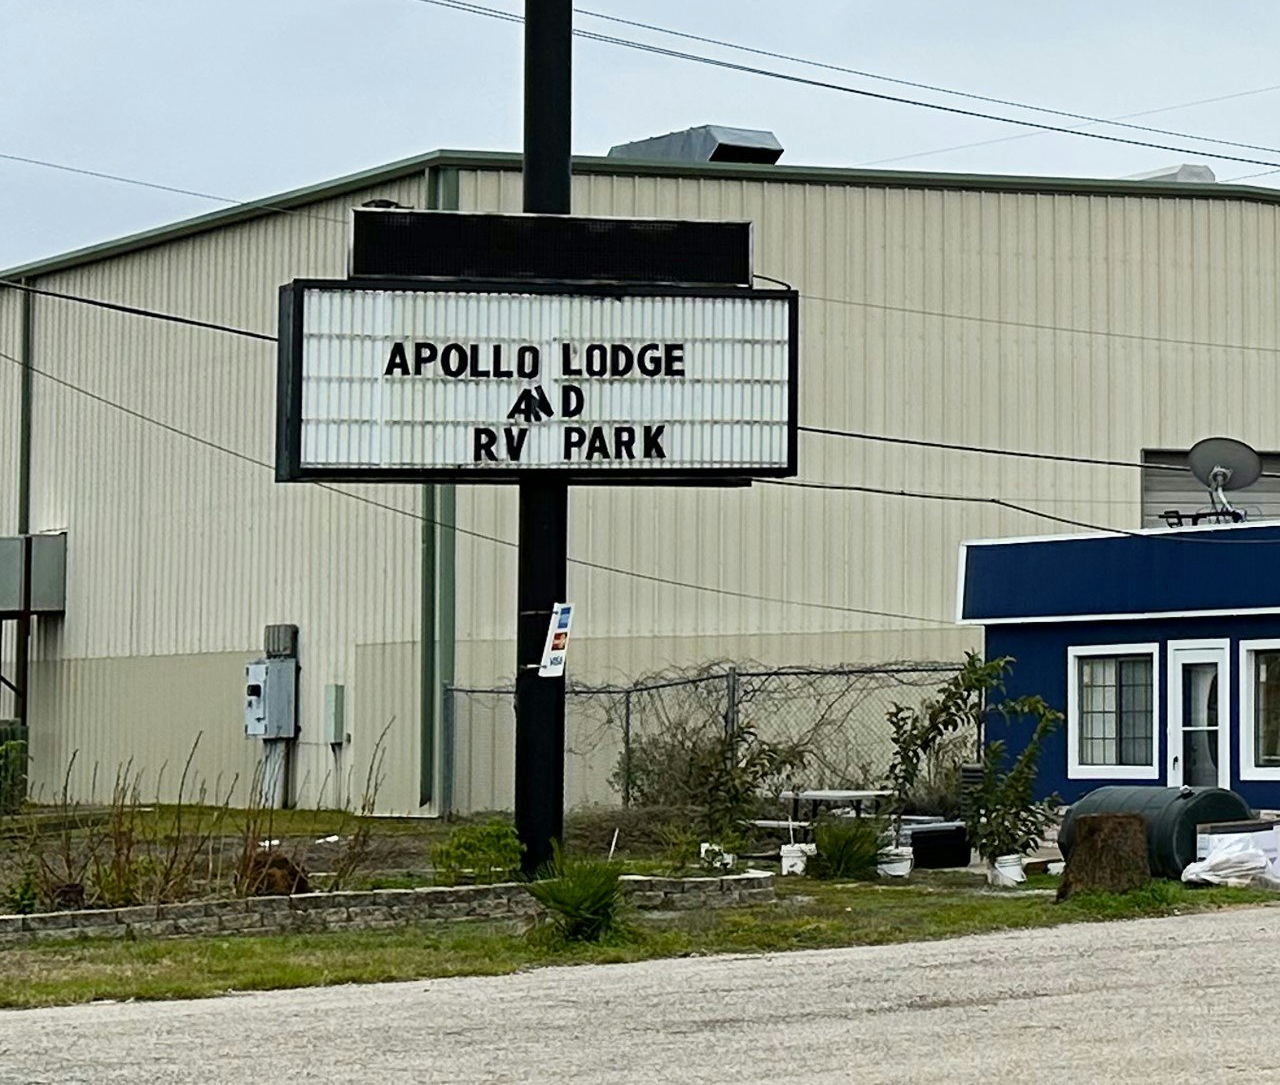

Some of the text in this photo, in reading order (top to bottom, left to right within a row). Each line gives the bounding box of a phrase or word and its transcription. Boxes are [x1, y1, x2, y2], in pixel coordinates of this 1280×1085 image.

[384, 342, 686, 379] APOLLO LODGE
[507, 384, 585, 423] AND
[473, 426, 667, 462] RV PARK
